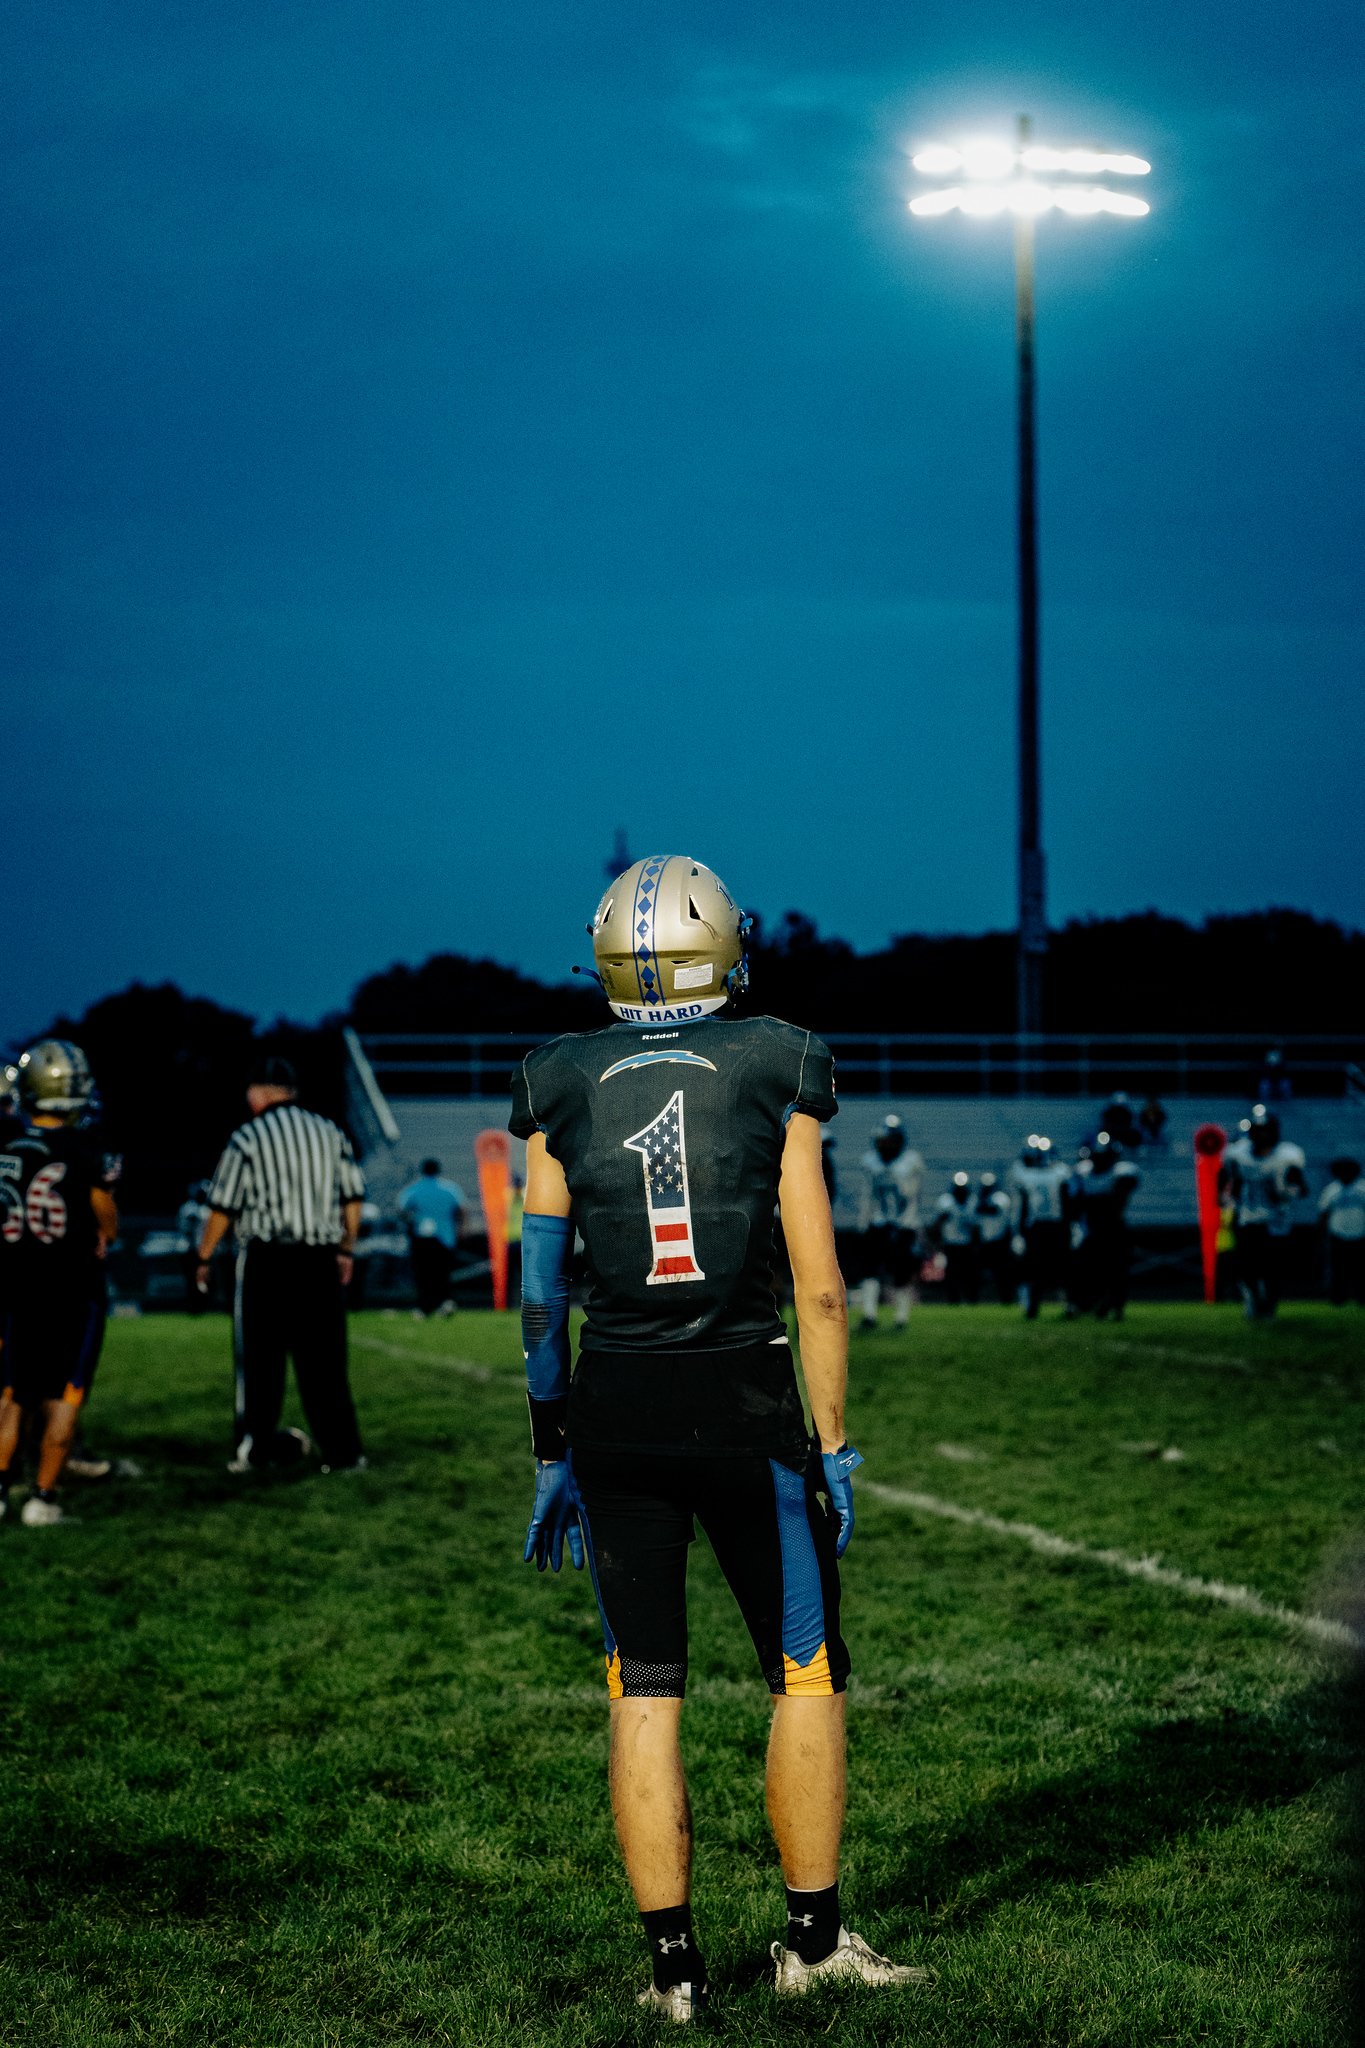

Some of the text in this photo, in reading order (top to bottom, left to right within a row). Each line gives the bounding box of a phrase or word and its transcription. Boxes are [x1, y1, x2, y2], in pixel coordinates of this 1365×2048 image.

[619, 1004, 702, 1021] HIT HARD
[641, 1032, 679, 1040] Riddell
[623, 1090, 706, 1286] 1
